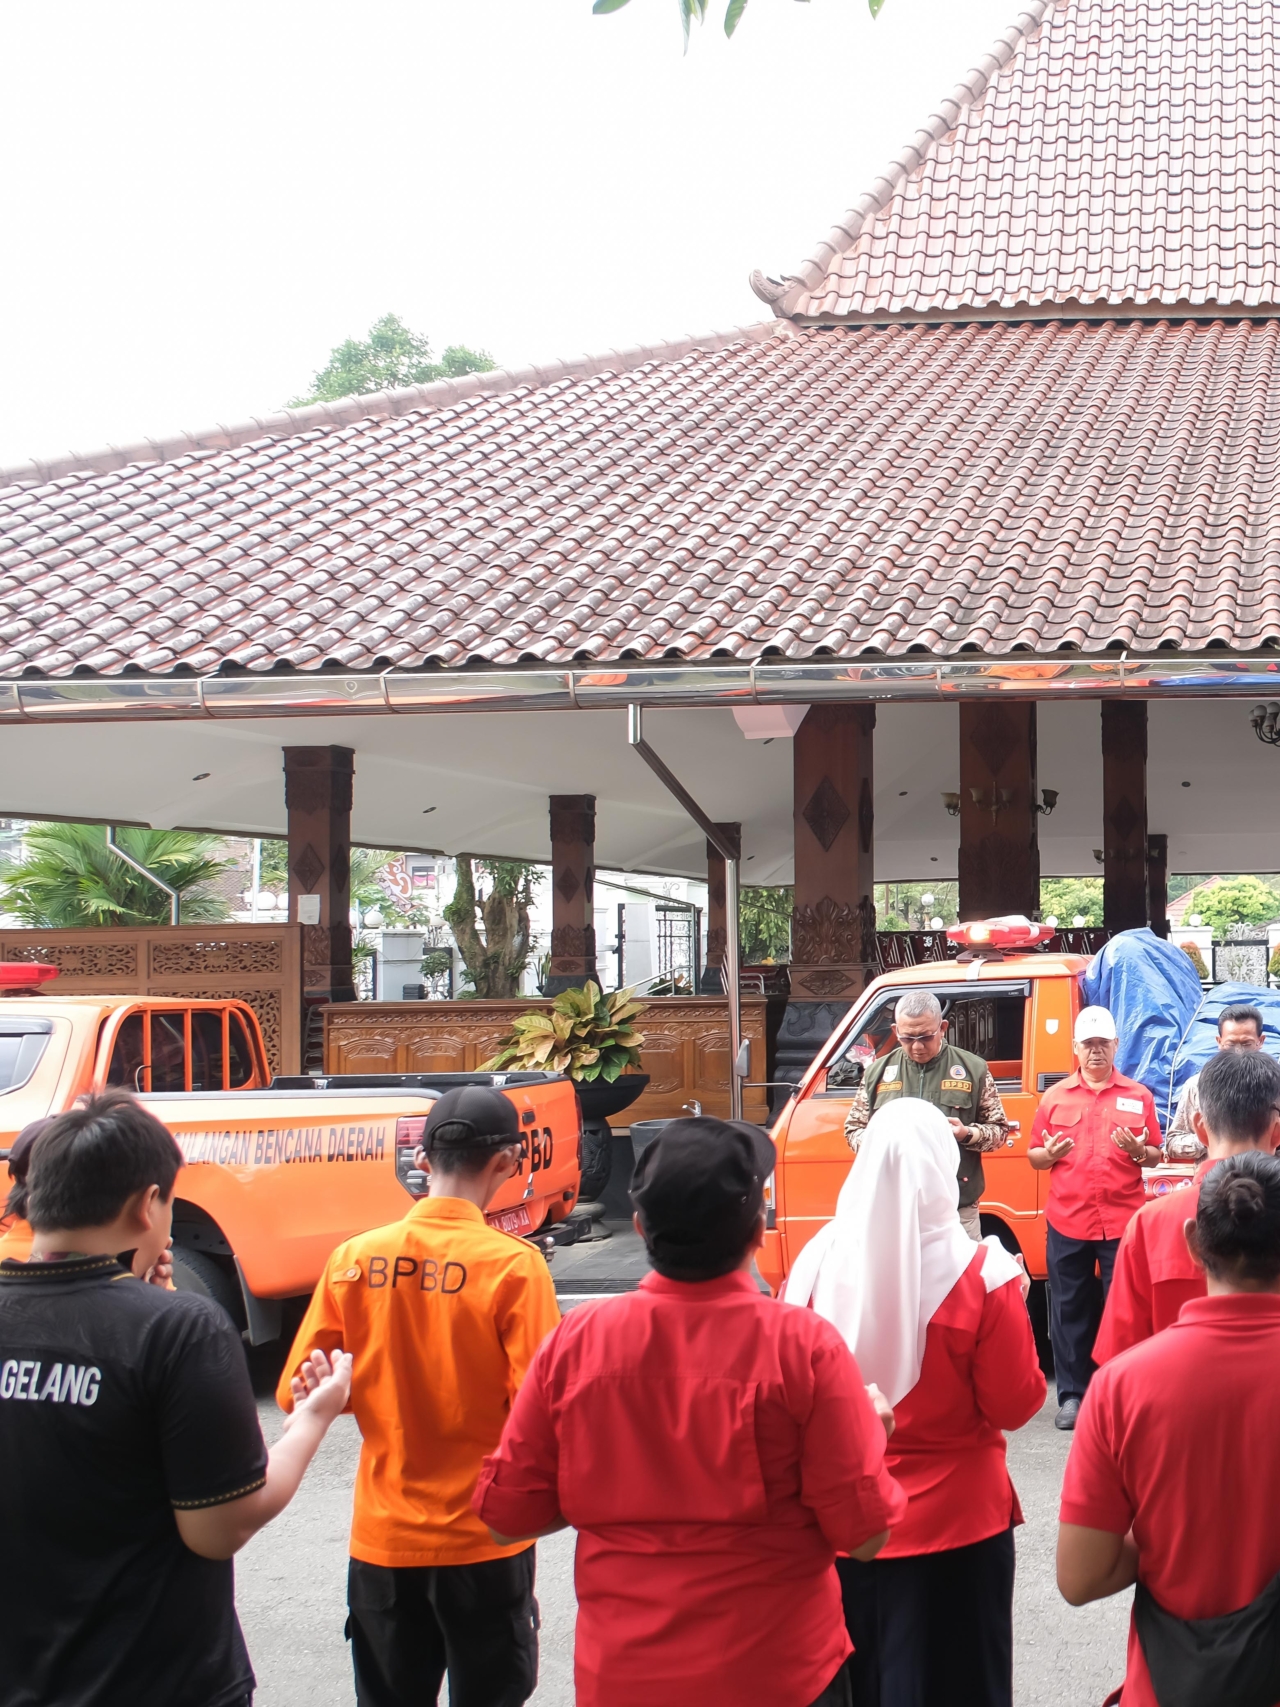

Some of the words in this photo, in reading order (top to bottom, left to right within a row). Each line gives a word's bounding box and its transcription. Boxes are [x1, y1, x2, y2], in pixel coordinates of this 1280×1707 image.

[253, 1128, 323, 1165] BENCANA
[327, 1126, 386, 1163] DAERAH
[509, 1126, 553, 1178] PBD
[368, 1256, 467, 1295] BPBD
